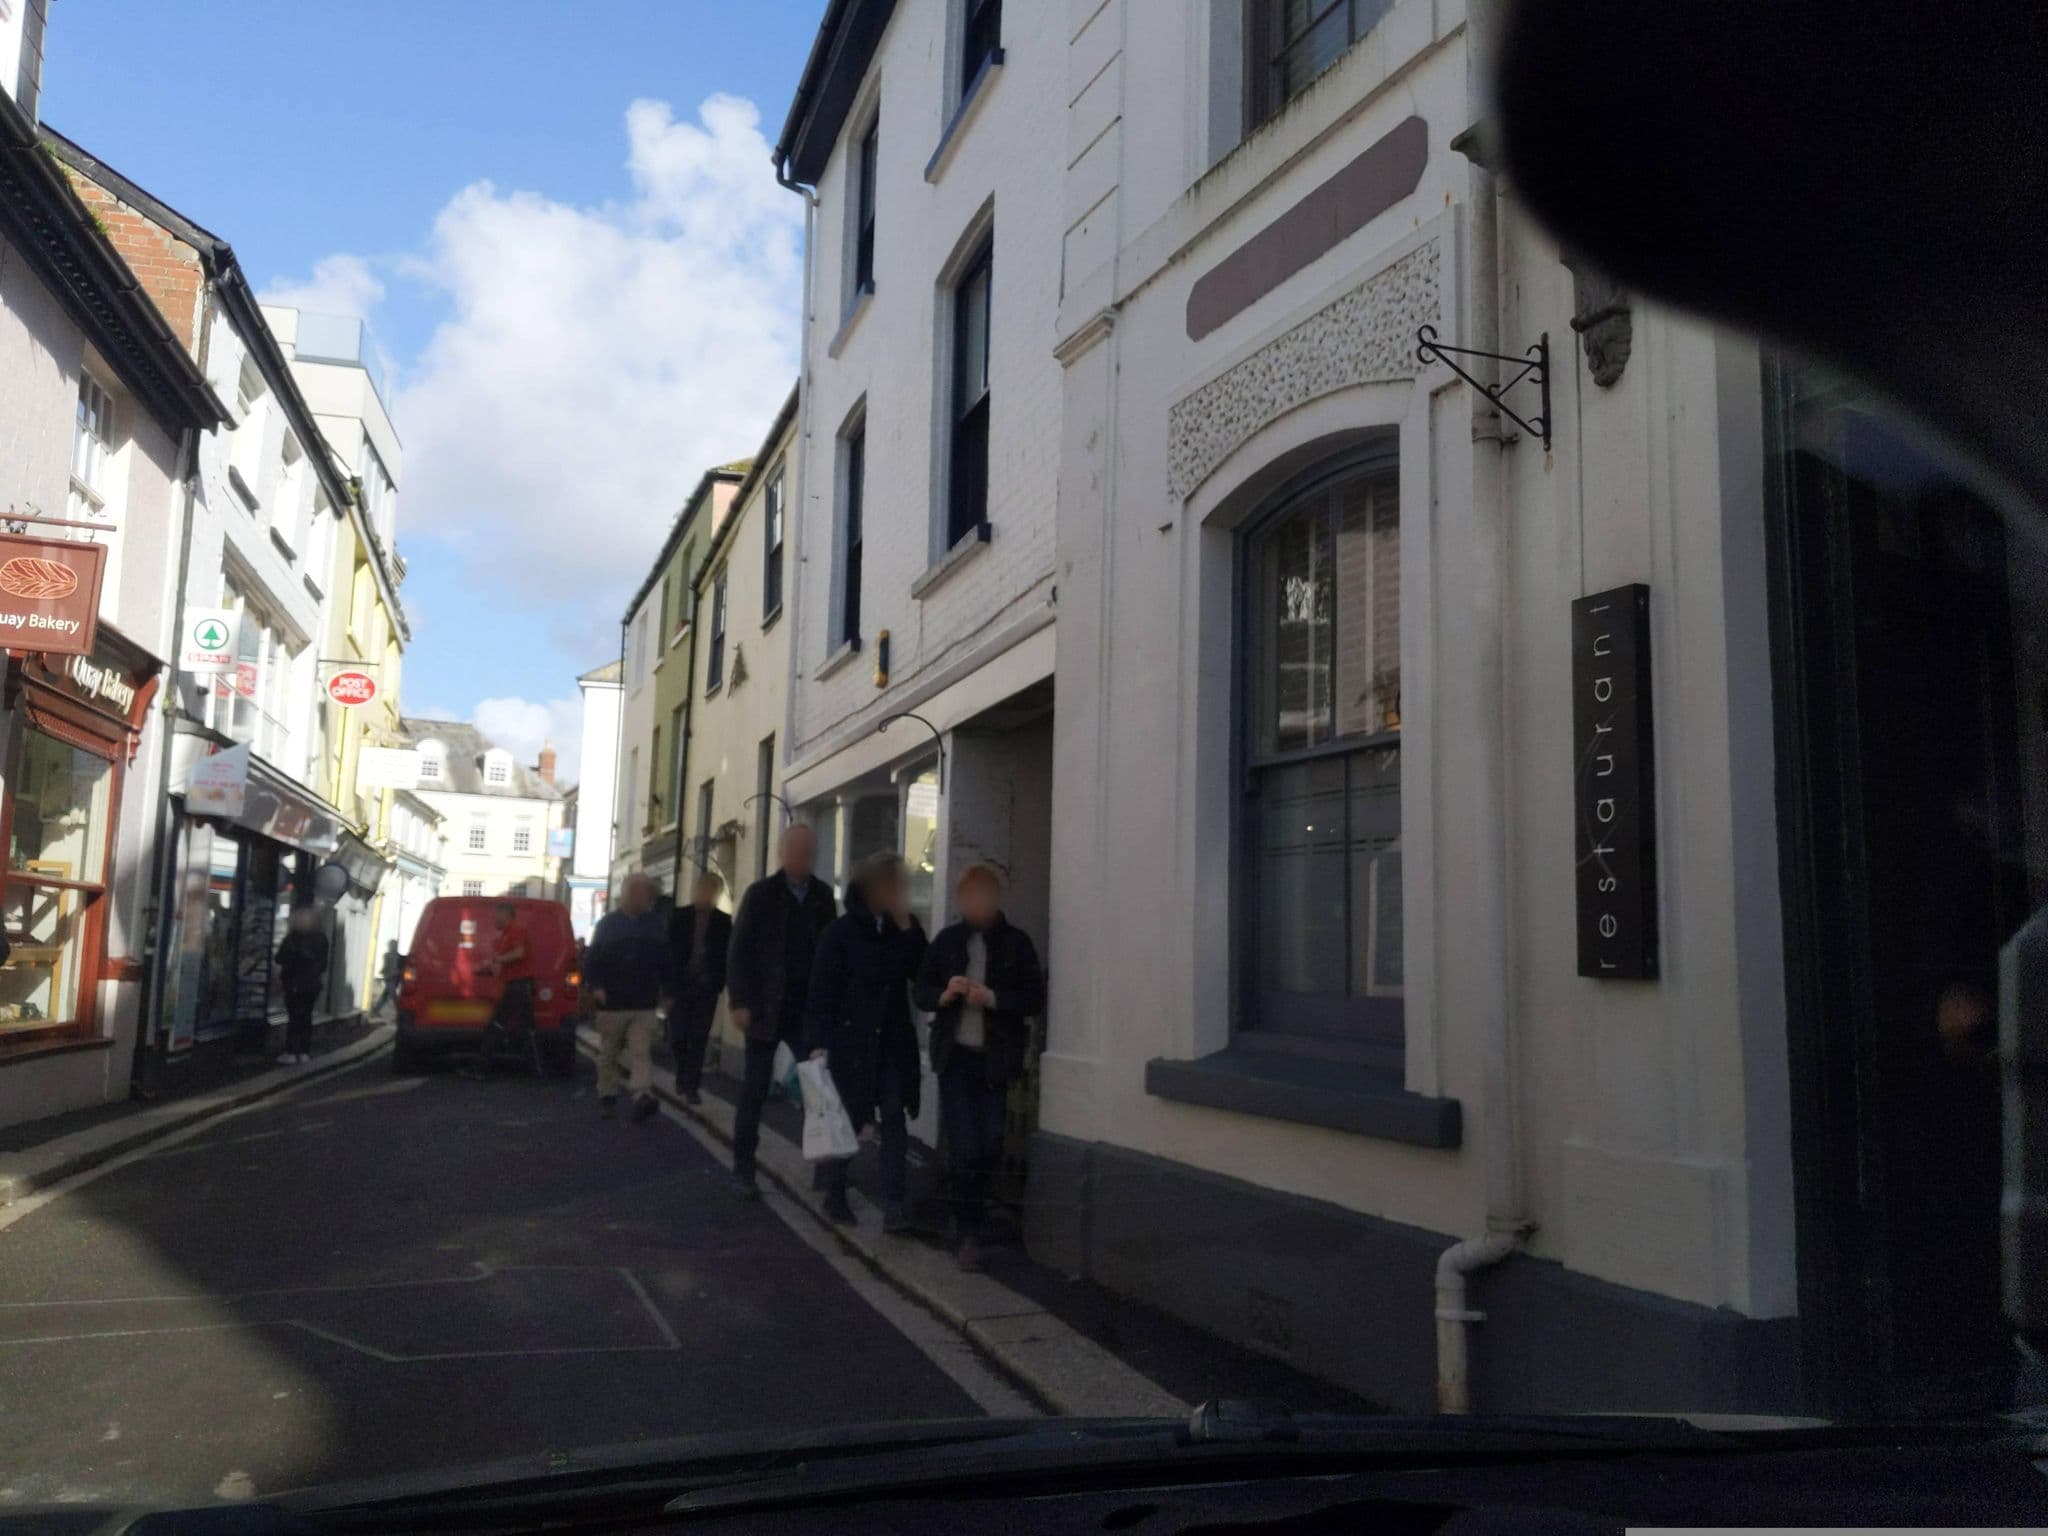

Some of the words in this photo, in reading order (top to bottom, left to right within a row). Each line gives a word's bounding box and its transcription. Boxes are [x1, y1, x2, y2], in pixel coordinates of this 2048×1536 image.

[0, 613, 26, 630] uay
[28, 613, 80, 635] Bakery
[339, 678, 368, 688] POST
[332, 687, 370, 699] OFFICE
[1589, 603, 1617, 969] restaurant
